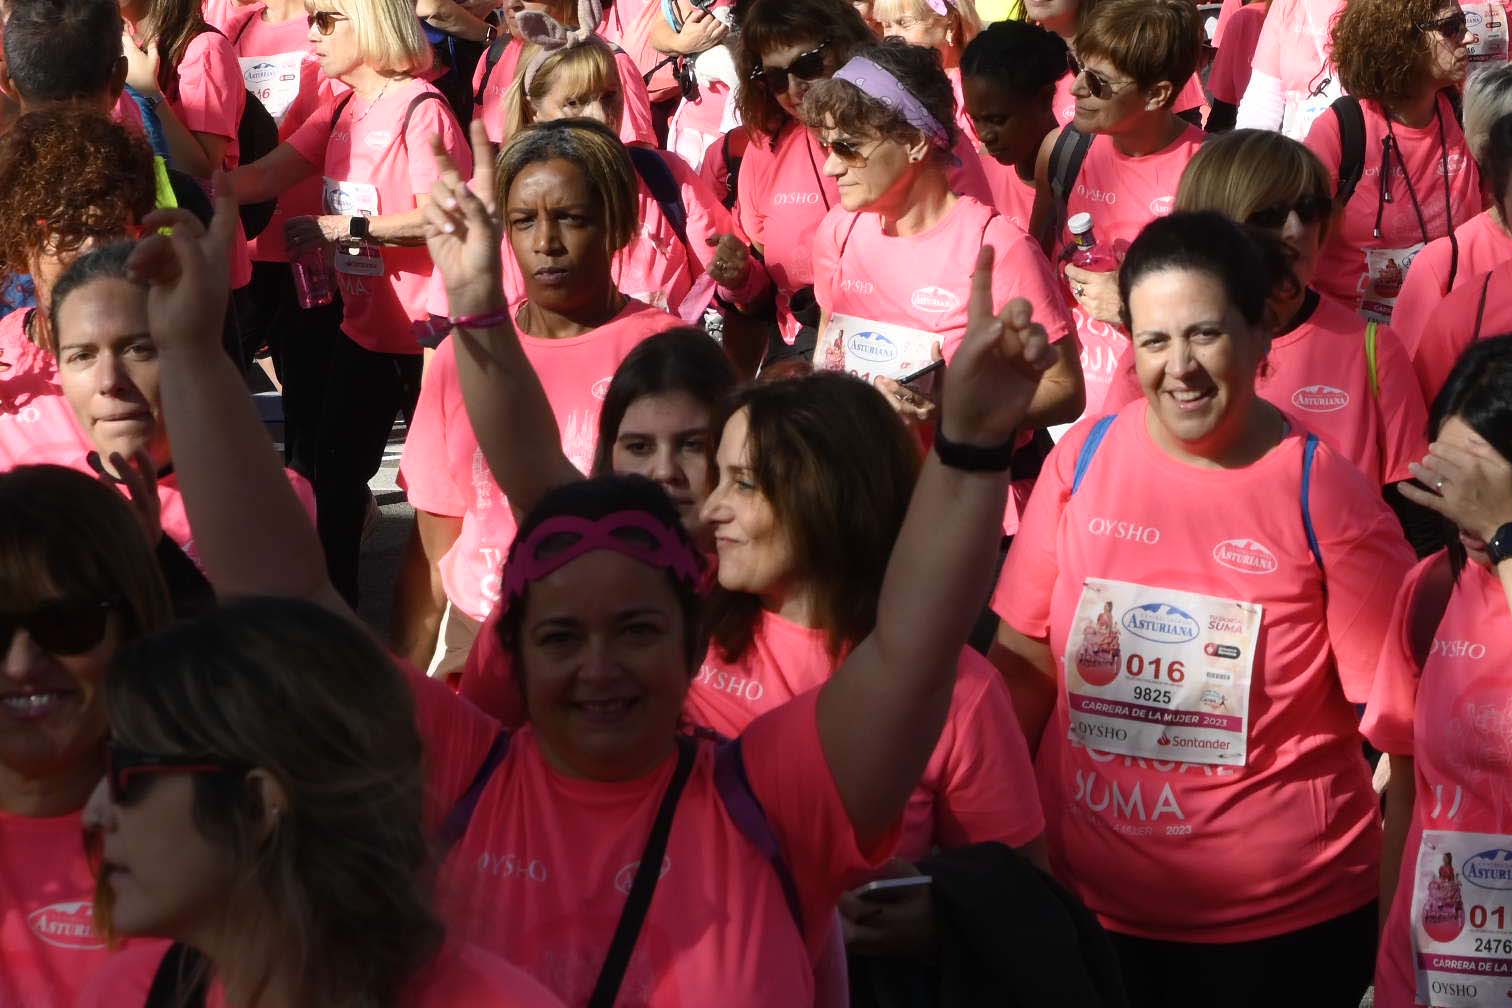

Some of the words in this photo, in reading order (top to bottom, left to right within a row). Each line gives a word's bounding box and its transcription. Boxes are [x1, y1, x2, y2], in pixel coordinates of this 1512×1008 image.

[852, 339, 894, 360] ASTURIANA
[1297, 393, 1345, 406] ASTURIANA
[1088, 517, 1160, 545] OYSHO
[1219, 549, 1273, 570] ASTURIANA
[1127, 613, 1193, 638] ASTURIANA
[1207, 621, 1244, 635] SUMA
[1126, 653, 1186, 684] 016
[1133, 686, 1172, 705] 9825
[1081, 700, 1129, 717] CARRERA
[1132, 707, 1147, 718] DE
[1148, 710, 1162, 721] LA
[1163, 713, 1200, 724] MUJER
[1203, 717, 1228, 727] 2023
[1078, 721, 1128, 742] OYSHO
[1172, 735, 1231, 751] Santander
[1432, 958, 1476, 971] CARRERA
[1479, 962, 1491, 972] DE
[1494, 963, 1508, 972] LA
[1432, 981, 1477, 999] OYSHO
